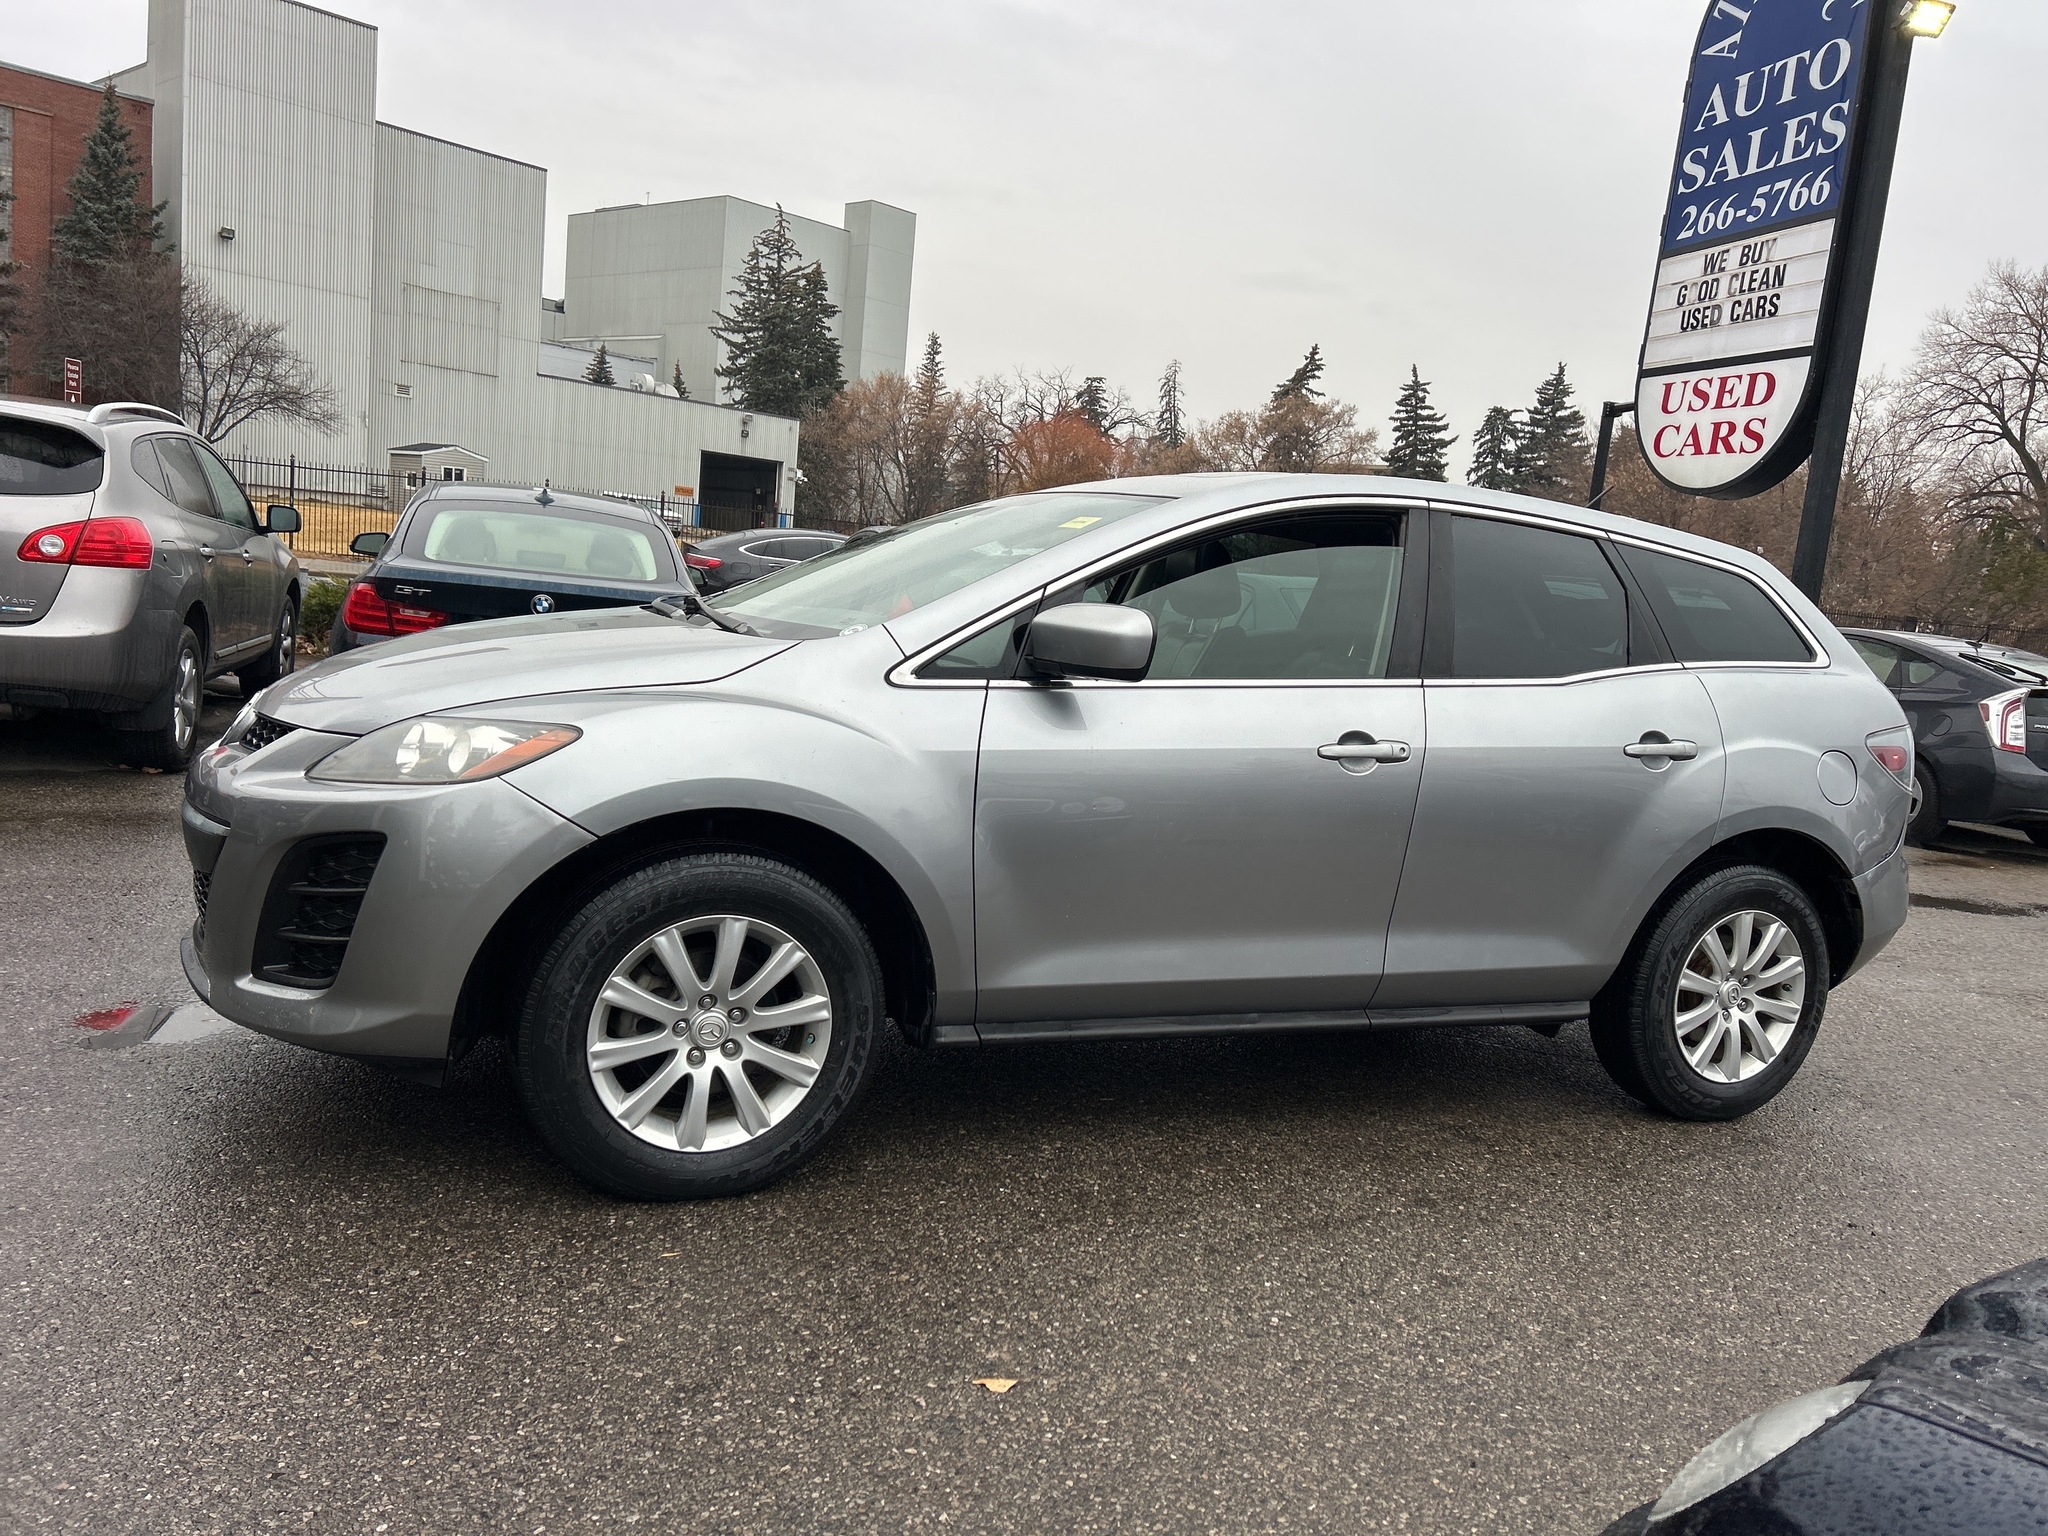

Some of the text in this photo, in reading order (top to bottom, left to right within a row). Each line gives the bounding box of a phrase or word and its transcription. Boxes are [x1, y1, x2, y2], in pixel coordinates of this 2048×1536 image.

[1693, 37, 1852, 132] AUTO
[1677, 98, 1851, 196] SALES
[1675, 164, 1836, 241] 266-5766
[1703, 238, 1778, 275] WE BUY
[1727, 263, 1788, 298] CLEAN
[1680, 293, 1781, 333] USED CARS
[1661, 371, 1778, 415] USED
[1653, 416, 1767, 459] CARS
[393, 584, 432, 596] GT
